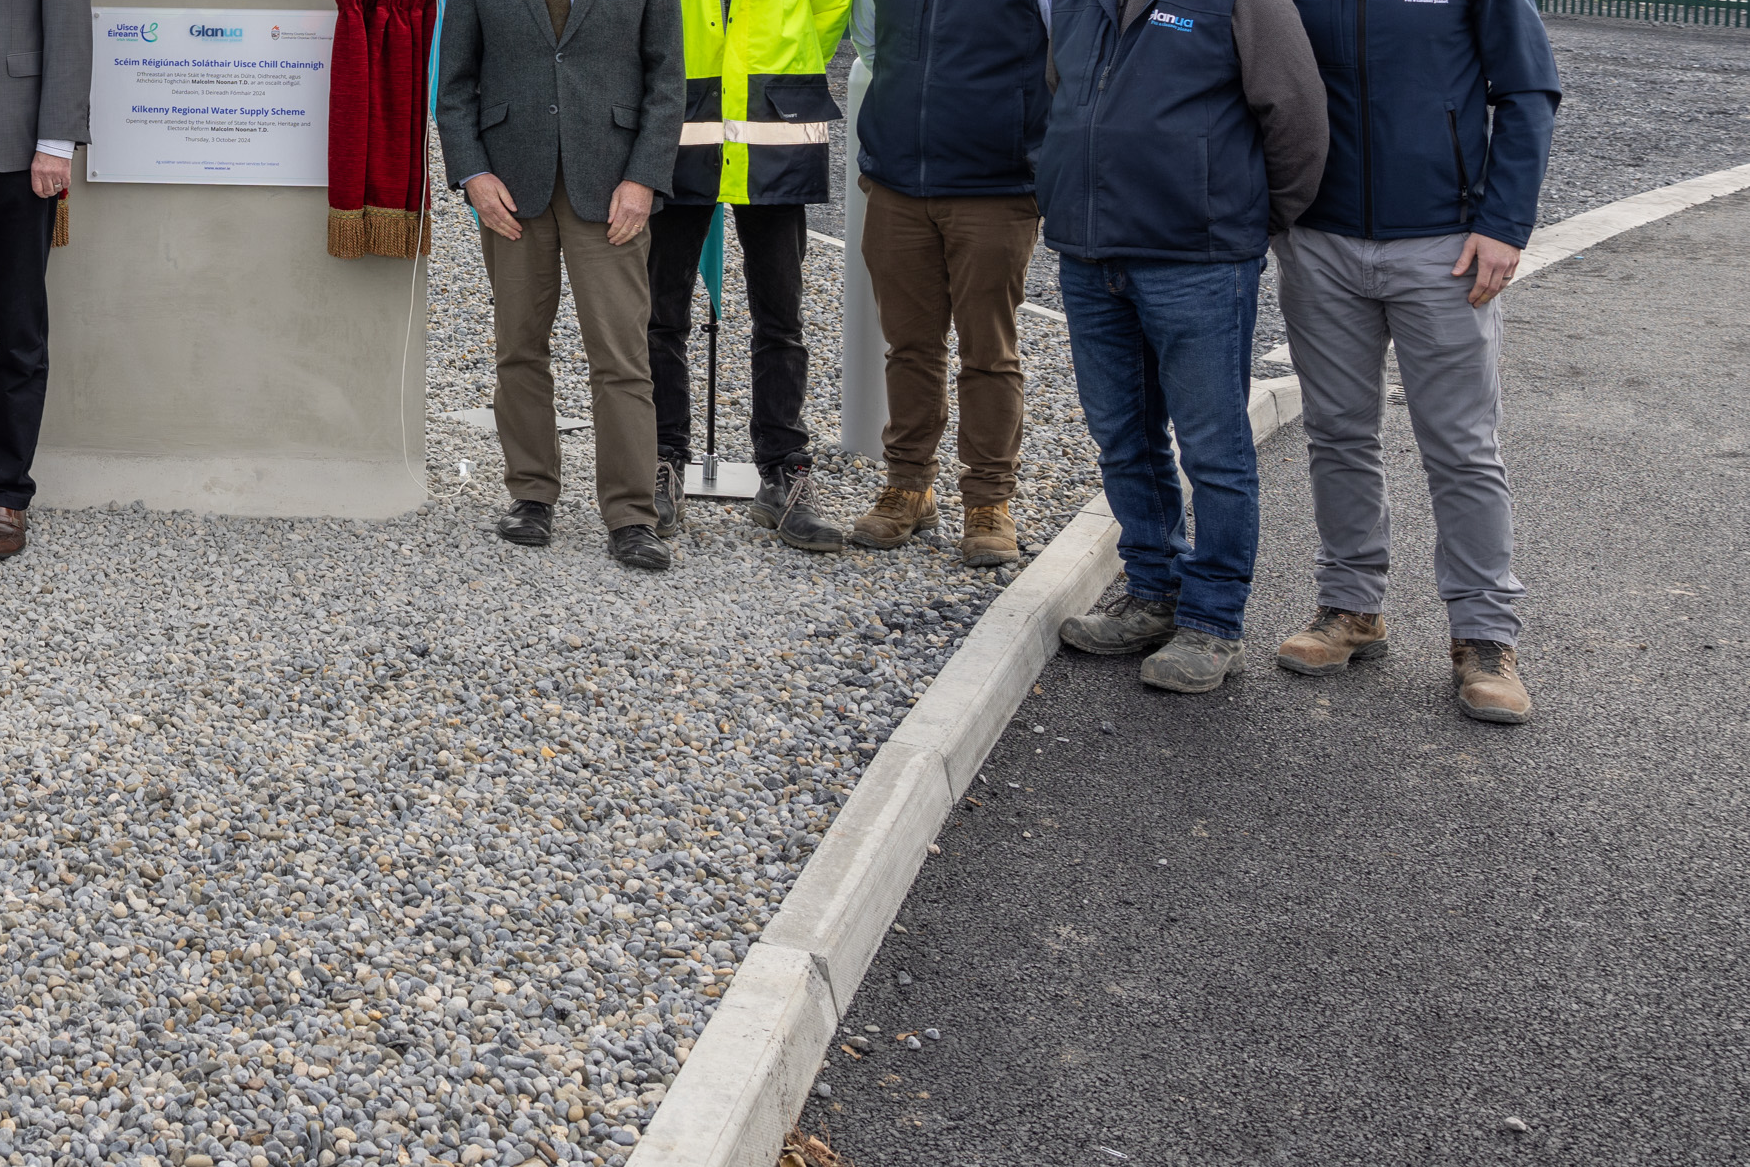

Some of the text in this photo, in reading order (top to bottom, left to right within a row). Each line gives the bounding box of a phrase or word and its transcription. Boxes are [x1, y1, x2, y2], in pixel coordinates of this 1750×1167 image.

[108, 29, 138, 37] Éireann
[190, 25, 242, 37] Glanua
[114, 58, 324, 70] Scéim Réigiúnach Soláthair Uisce Chill Chainnigh
[132, 105, 169, 115] Kilkenny
[172, 106, 209, 115] Regional
[240, 107, 269, 117] Supply
